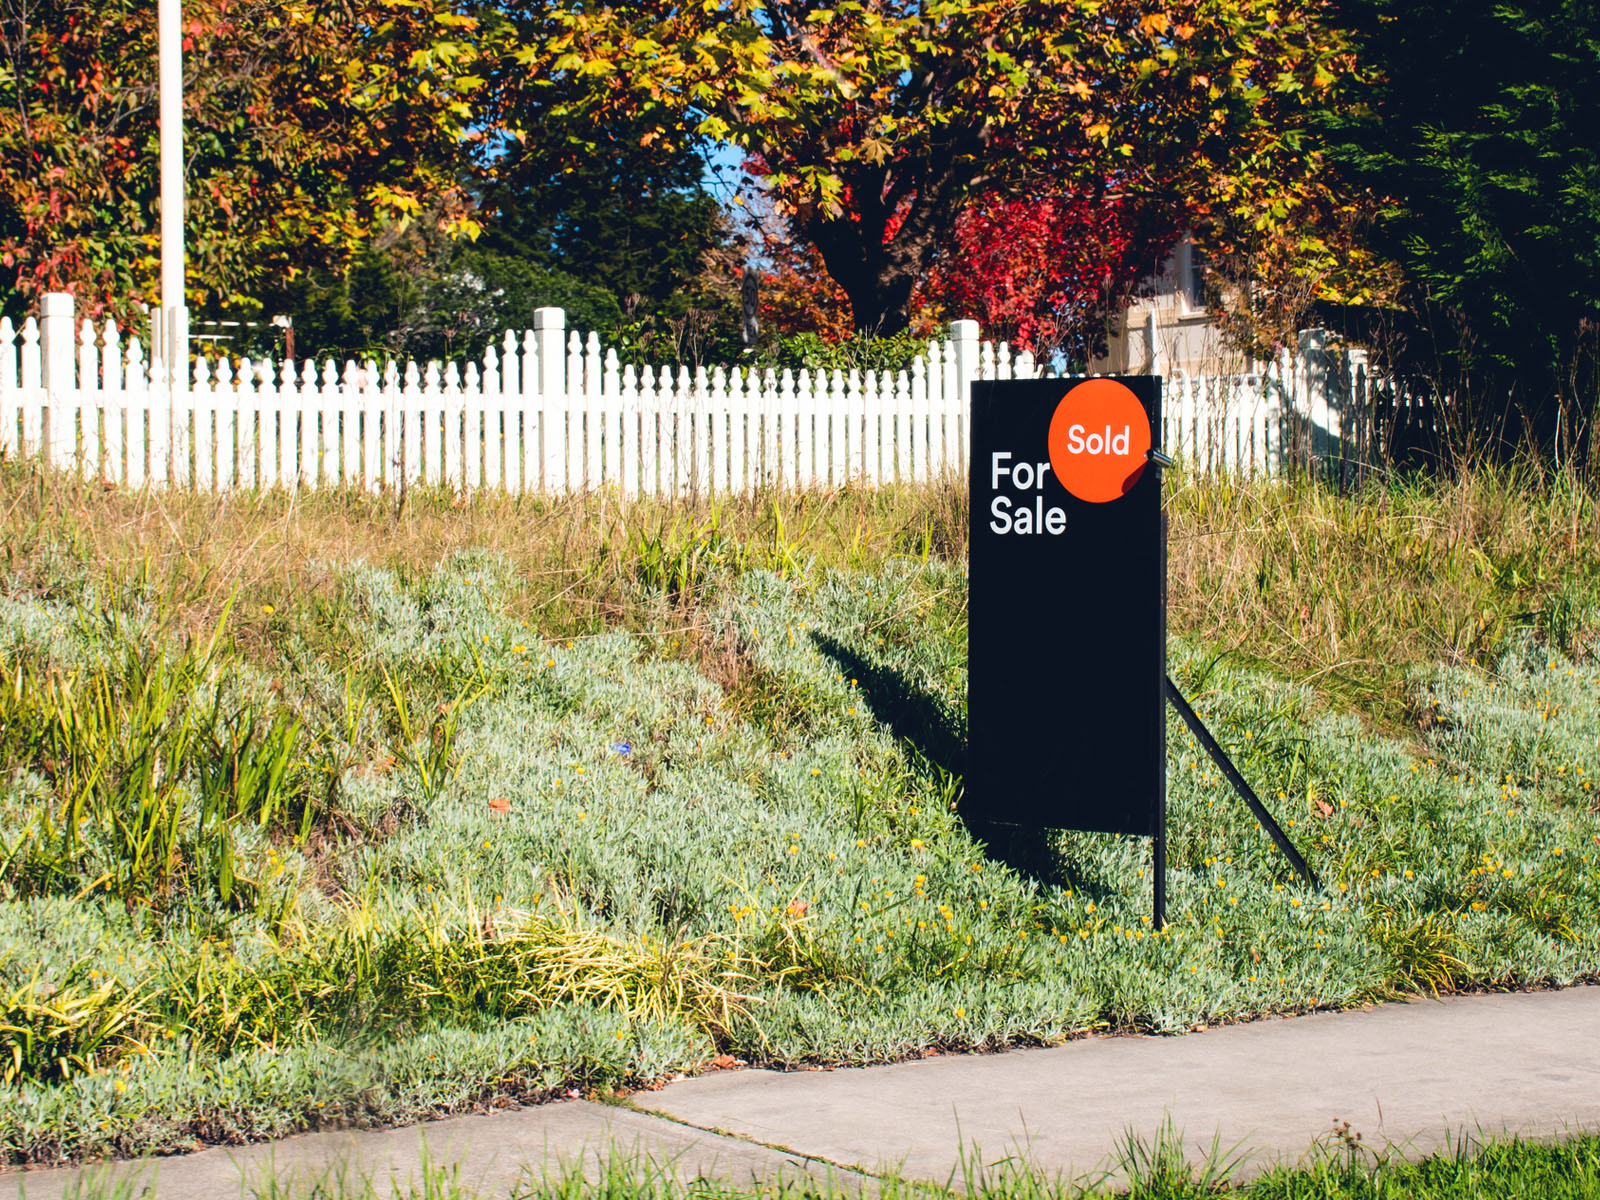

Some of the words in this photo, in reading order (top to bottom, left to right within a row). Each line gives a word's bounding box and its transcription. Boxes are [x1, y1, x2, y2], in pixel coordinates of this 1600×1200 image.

[1067, 424, 1130, 455] Sold
[992, 452, 1051, 490] For
[989, 495, 1067, 535] Sale
